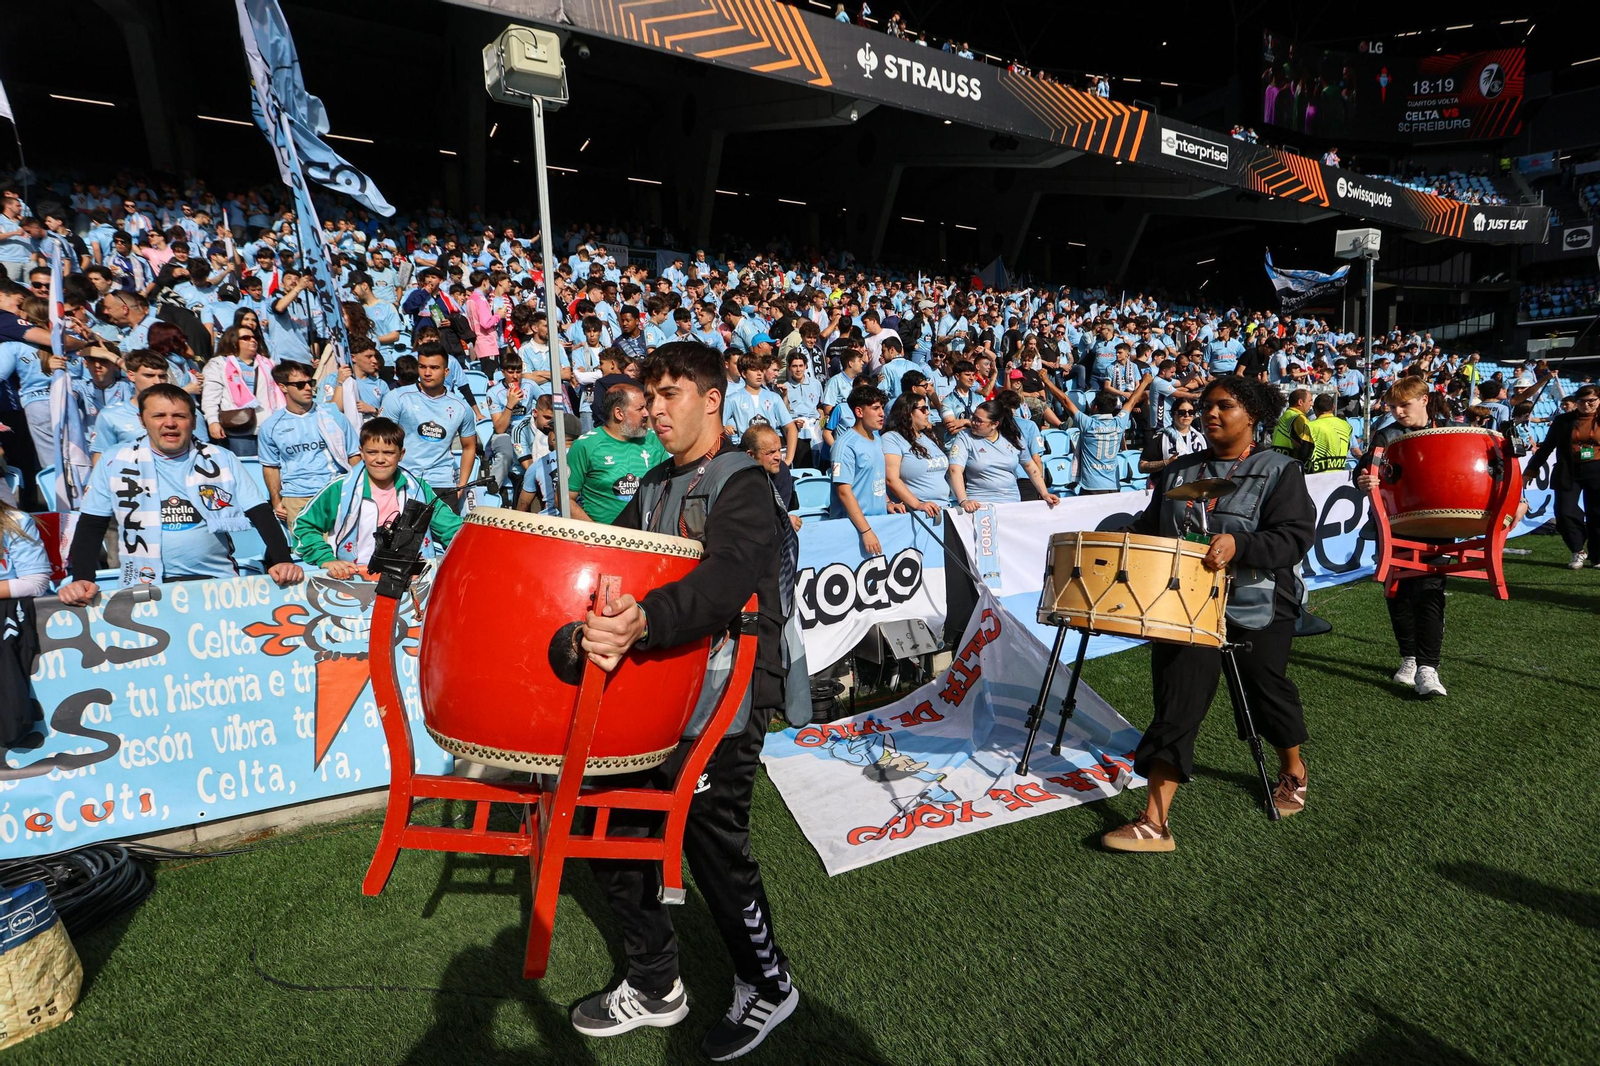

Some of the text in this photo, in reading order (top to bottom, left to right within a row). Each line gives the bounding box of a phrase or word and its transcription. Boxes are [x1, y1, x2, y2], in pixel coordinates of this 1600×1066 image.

[1369, 41, 1383, 54] LG
[884, 54, 982, 101] STRAUSS
[1413, 78, 1454, 95] 18:19
[1398, 119, 1471, 132] SC FREIBURG
[1405, 108, 1460, 121] CELTA VS
[1165, 136, 1227, 163] enterprise
[1347, 181, 1392, 208] Swissquote
[1487, 219, 1528, 231] JUST EAT
[1094, 432, 1119, 460] 10
[161, 505, 194, 514] strella
[981, 515, 994, 556] FORA
[202, 576, 270, 611] noble
[917, 620, 925, 630] 5
[188, 619, 257, 660] Celta
[939, 608, 1002, 707] CELTA
[126, 681, 159, 718] tu
[164, 667, 262, 713] historia
[268, 669, 285, 697] e
[119, 723, 194, 770] tesón
[211, 713, 277, 754] vibra
[197, 759, 296, 804] Celta,
[988, 782, 1061, 811] DE
